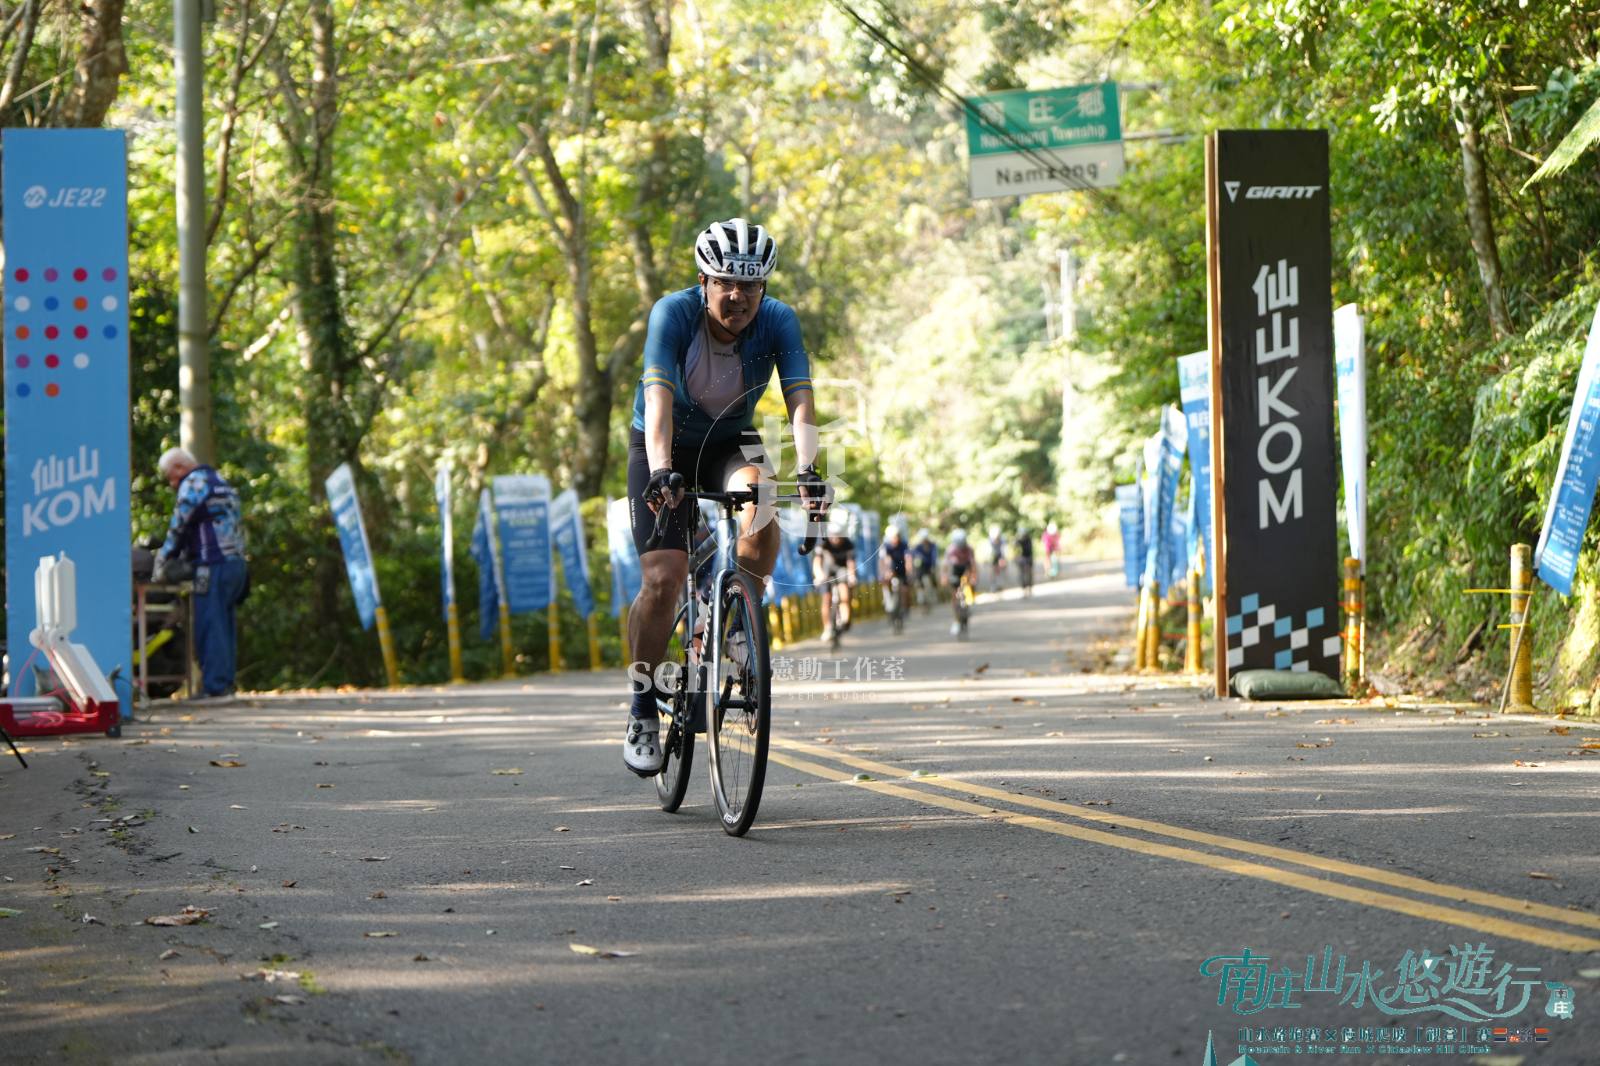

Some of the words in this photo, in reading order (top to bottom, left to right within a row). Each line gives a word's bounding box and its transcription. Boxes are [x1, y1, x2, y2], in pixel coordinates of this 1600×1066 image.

[48, 187, 107, 208] JE22
[1245, 185, 1322, 199] GIANT
[726, 261, 762, 277] 4167
[1252, 258, 1299, 365] 仙山
[31, 445, 99, 496] 仙山
[1257, 366, 1303, 530] KOM
[22, 476, 117, 537] KOM
